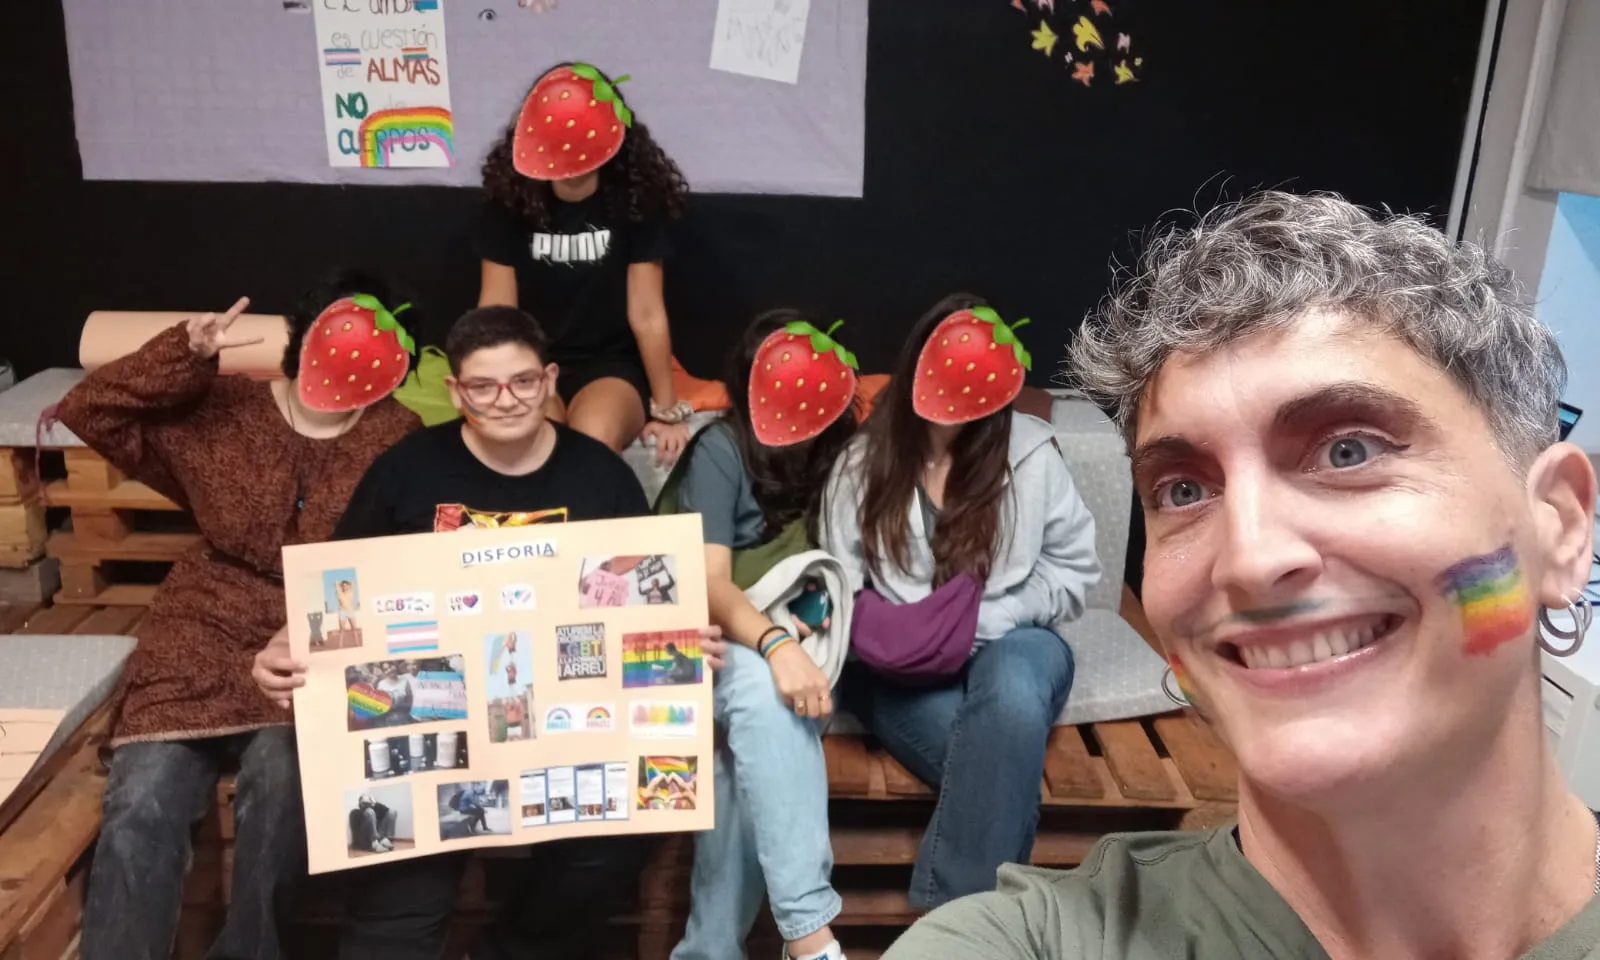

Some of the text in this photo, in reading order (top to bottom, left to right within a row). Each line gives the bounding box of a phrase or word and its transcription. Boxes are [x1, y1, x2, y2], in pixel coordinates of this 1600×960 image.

[331, 31, 352, 48] es
[367, 57, 440, 86] ALMAS
[335, 91, 368, 119] NO
[462, 543, 555, 565] DISFORIA
